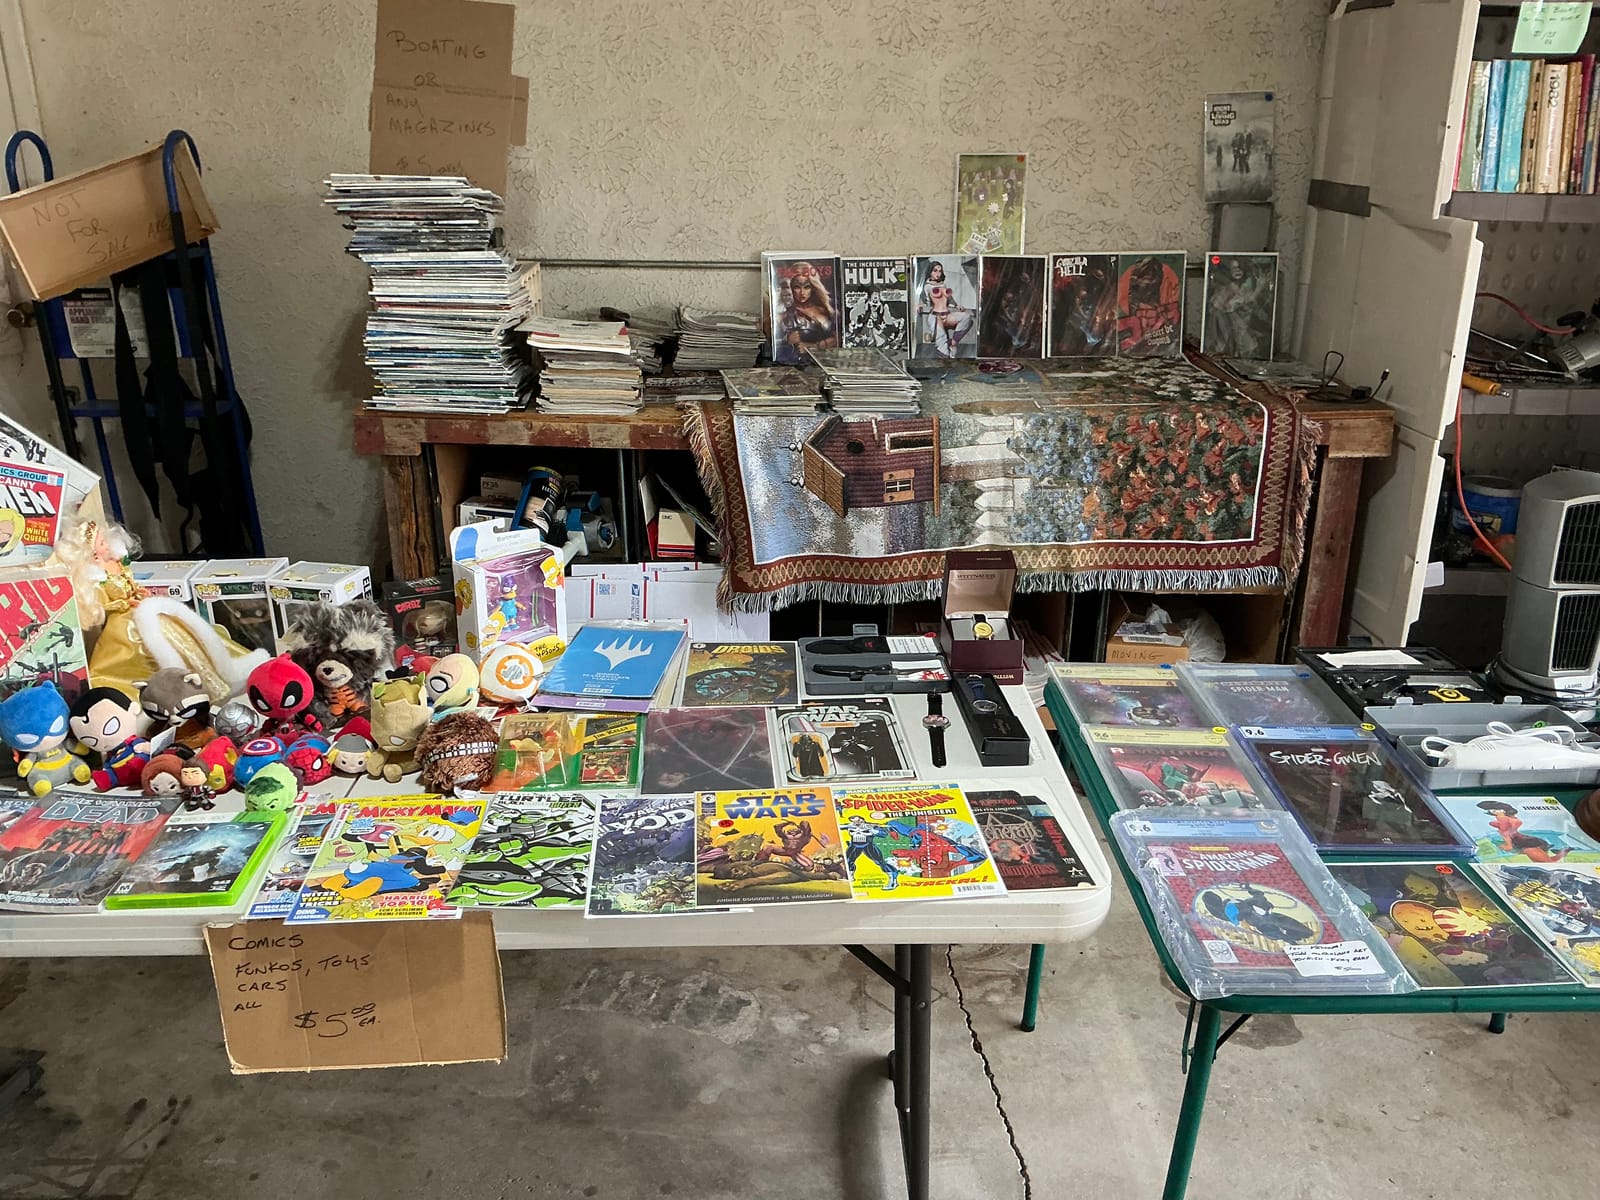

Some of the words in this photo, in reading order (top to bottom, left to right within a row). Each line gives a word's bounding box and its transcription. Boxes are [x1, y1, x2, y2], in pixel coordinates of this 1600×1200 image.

[386, 30, 487, 59] BOATING
[414, 72, 442, 88] OR
[389, 117, 496, 136] MAGAZINES
[32, 187, 86, 226] NOT
[66, 218, 109, 242] FOR
[844, 268, 899, 285] HULK
[17, 471, 48, 481] GROUP
[0, 477, 36, 489] CANNY
[0, 484, 57, 515] MEN
[26, 527, 49, 536] WHITE
[169, 588, 180, 596] 69
[711, 645, 788, 654] DROIDS
[805, 706, 860, 714] STAR
[803, 713, 876, 723] WARS
[1269, 750, 1382, 766] SPIDER-GWEN
[499, 794, 583, 803] TURTLES
[730, 793, 824, 807] STAR
[866, 790, 930, 801] AMAZING
[842, 793, 955, 812] SPIDER-MAN
[39, 801, 161, 825] DEAD
[355, 806, 419, 818] MICKY
[724, 806, 825, 819] WARS
[622, 808, 695, 835] YOD
[1182, 853, 1280, 872] SPIDER-MAN
[1199, 850, 1255, 862] AMAZING
[911, 876, 988, 887] JACKAL!
[228, 934, 304, 950] COMICS
[235, 959, 311, 978] FUNKOS,
[317, 954, 372, 971] TOYS
[237, 979, 289, 992] CARS
[233, 1001, 262, 1012] ALL
